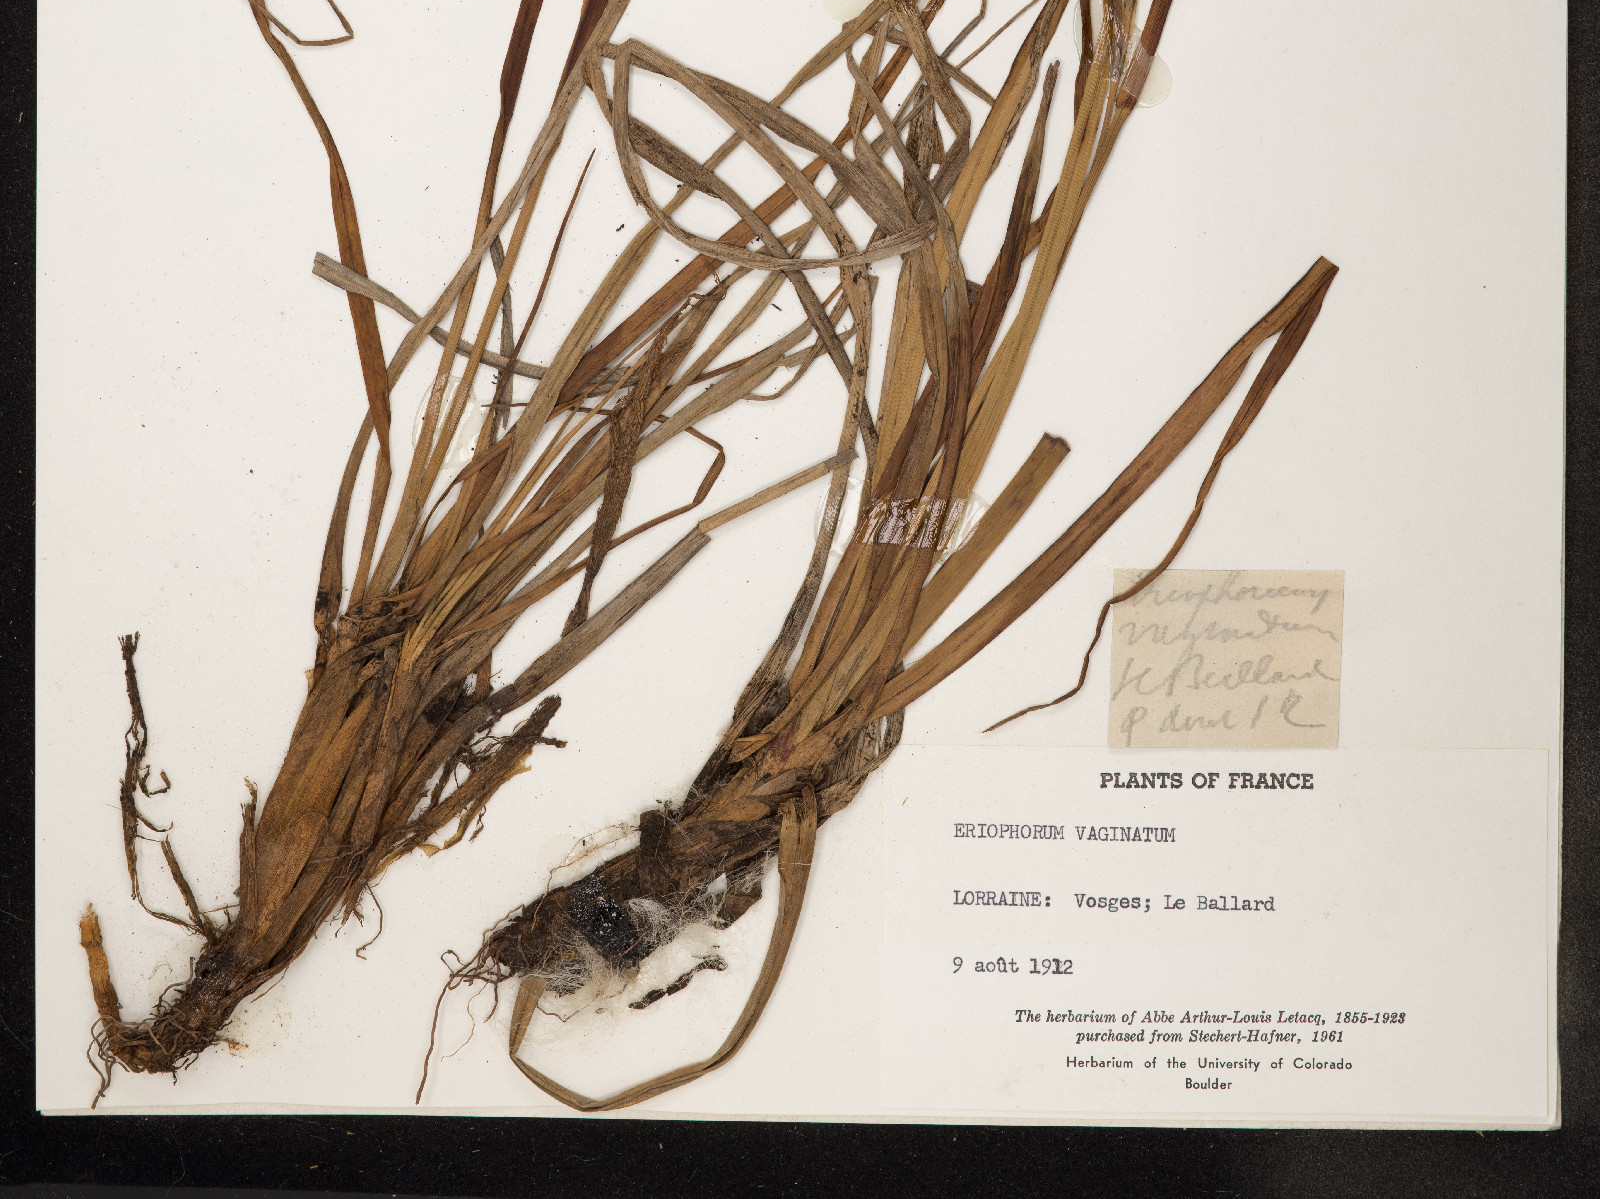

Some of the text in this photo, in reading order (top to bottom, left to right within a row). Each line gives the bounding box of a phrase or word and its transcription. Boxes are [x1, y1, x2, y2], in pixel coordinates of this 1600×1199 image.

[1099, 771, 1315, 791] PLANTS OF FRANCE
[953, 823, 1177, 843] ERIOPHORUM VAGINATUM
[953, 889, 1276, 913] LORRAINE: Vosges; Le Ballard
[952, 956, 964, 974] 9
[974, 956, 1020, 974] août
[1014, 1009, 1042, 1023] The
[1046, 1009, 1117, 1024] herbarium
[1121, 1010, 1138, 1026] of
[1141, 1010, 1176, 1024] Abbe
[1180, 1010, 1272, 1024] Arthur-Louis
[1276, 1010, 1327, 1027] Letacq,
[1075, 1028, 1344, 1045] purchased from Stechert-Hafner, 1961
[1066, 1055, 1353, 1073] Herbarium of the University of Colorado
[1185, 1077, 1233, 1090] Boulder
